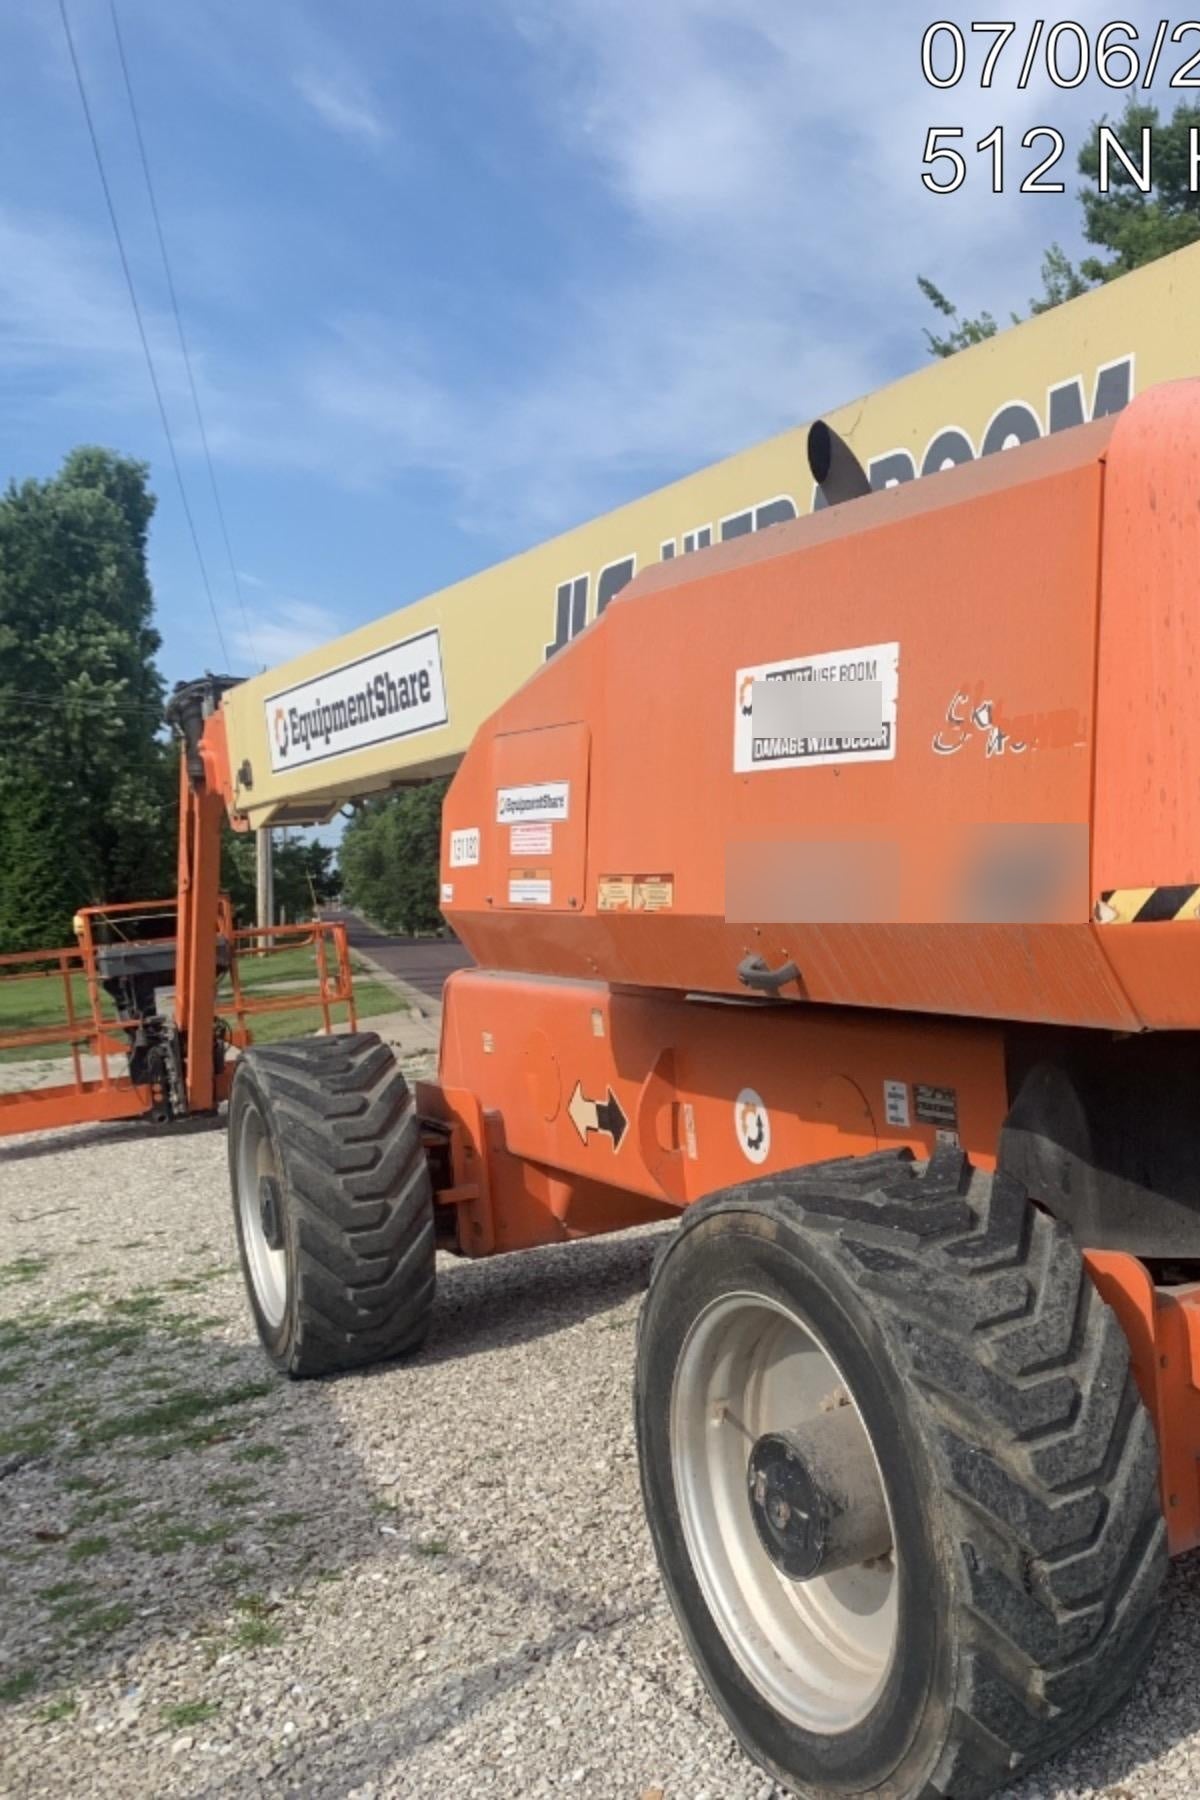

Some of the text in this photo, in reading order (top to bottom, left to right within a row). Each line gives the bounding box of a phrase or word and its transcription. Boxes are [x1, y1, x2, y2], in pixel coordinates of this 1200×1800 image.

[839, 660, 877, 682] BOOM
[288, 667, 432, 751] EquipmentShare
[755, 738, 805, 759] DAMAGE
